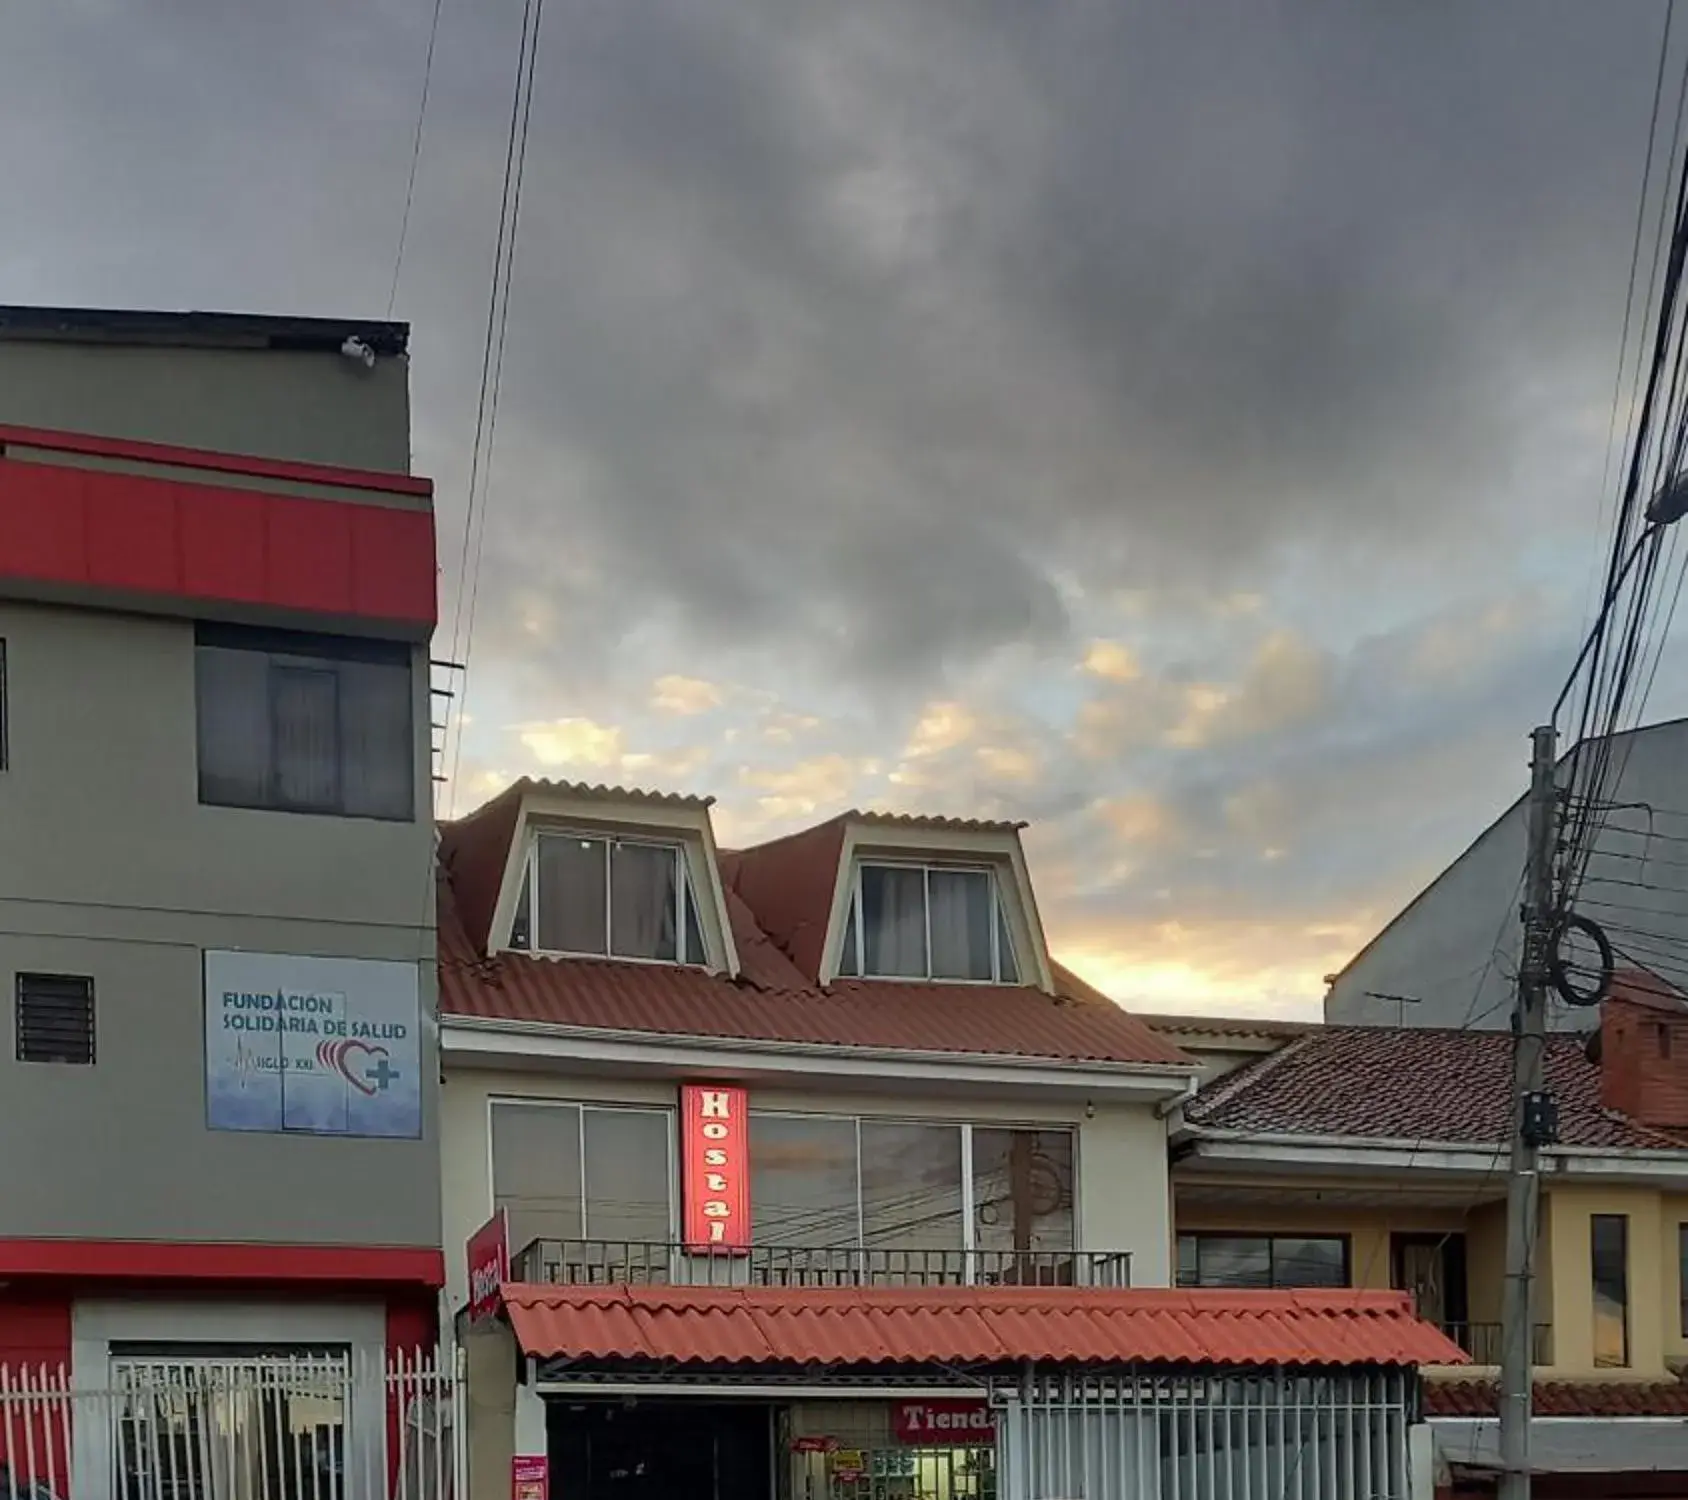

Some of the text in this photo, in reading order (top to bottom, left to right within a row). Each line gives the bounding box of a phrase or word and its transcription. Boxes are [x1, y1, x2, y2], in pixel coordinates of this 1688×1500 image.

[223, 1013, 406, 1038] SOLIDARIA DE SALUD
[701, 1092, 731, 1242] Hostal
